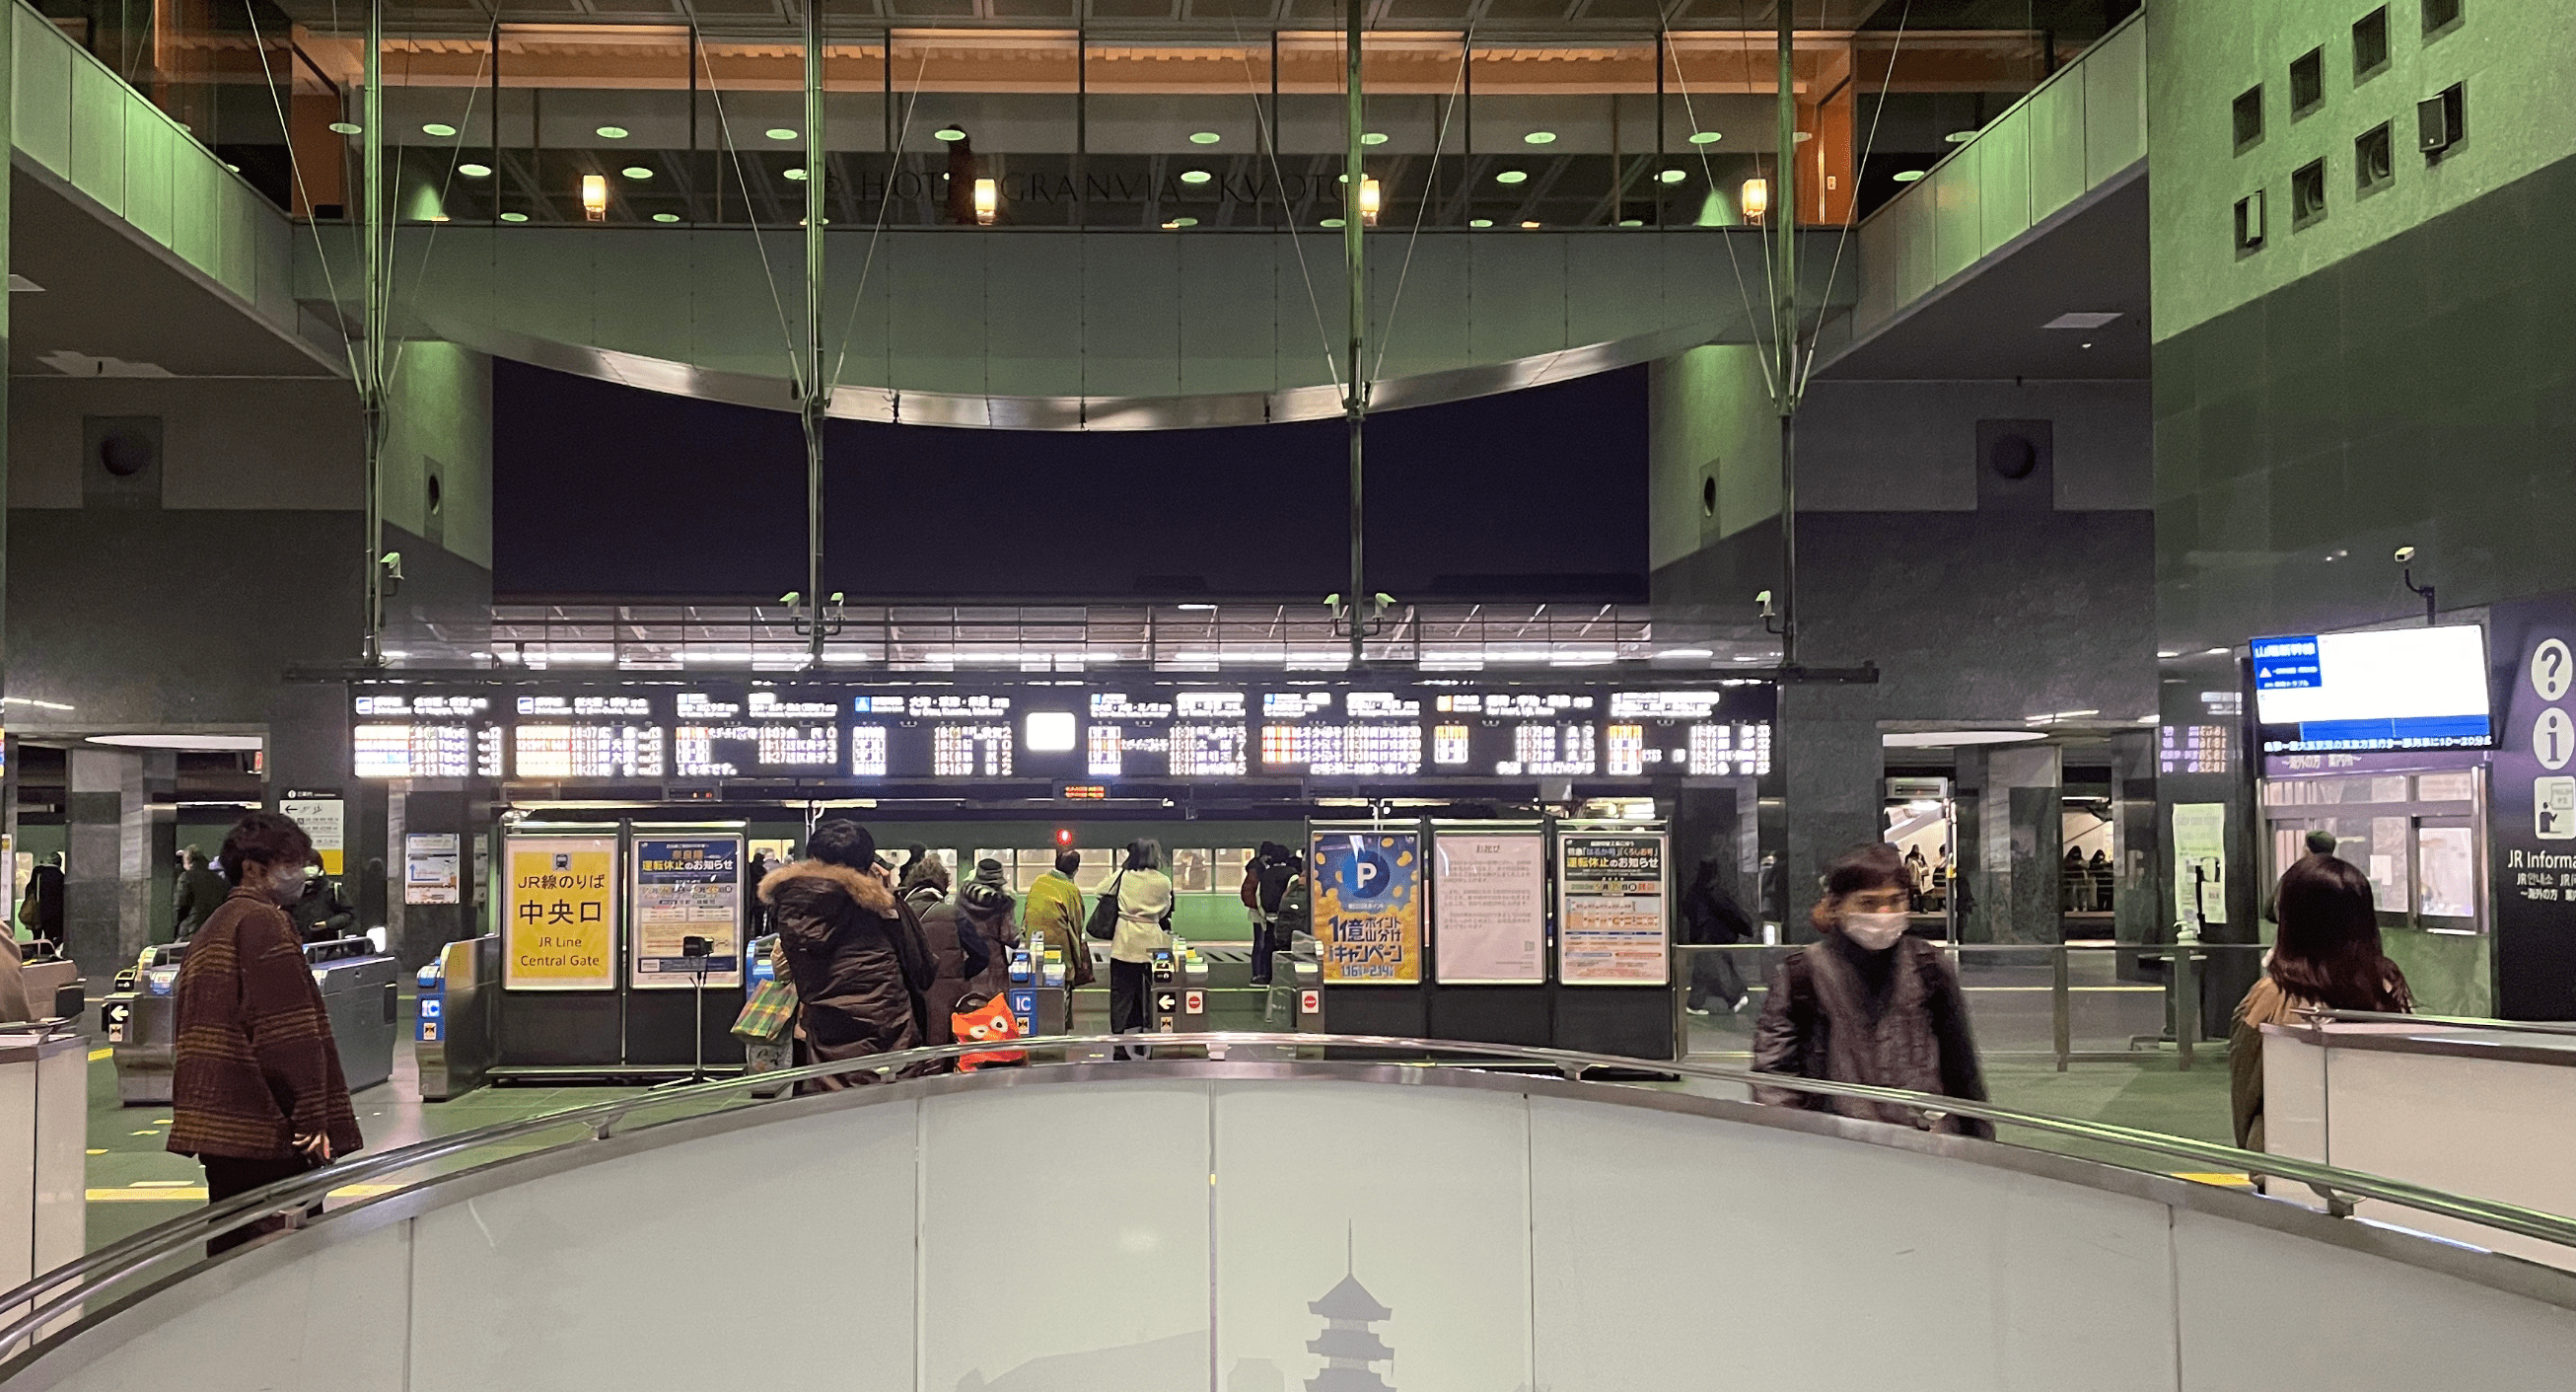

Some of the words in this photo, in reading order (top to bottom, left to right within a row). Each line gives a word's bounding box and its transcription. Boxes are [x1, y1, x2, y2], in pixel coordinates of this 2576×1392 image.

[1000, 172, 1181, 204] GRANVIA
[643, 860, 733, 871] 運転休止のお知らせ
[1567, 857, 1659, 868] 運転休止のお知らせ
[2508, 848, 2523, 868] JR
[518, 874, 605, 890] JR線のりば
[1357, 862, 1378, 889] P
[520, 899, 601, 924] 中央口
[1365, 917, 1401, 928] ポイント
[539, 937, 552, 947] JR
[556, 937, 582, 947] Line
[1365, 929, 1401, 942] 山分け
[521, 955, 566, 967] Central
[570, 955, 600, 967] Gate
[1335, 944, 1402, 963] キャンペーン
[1016, 996, 1032, 1011] IC
